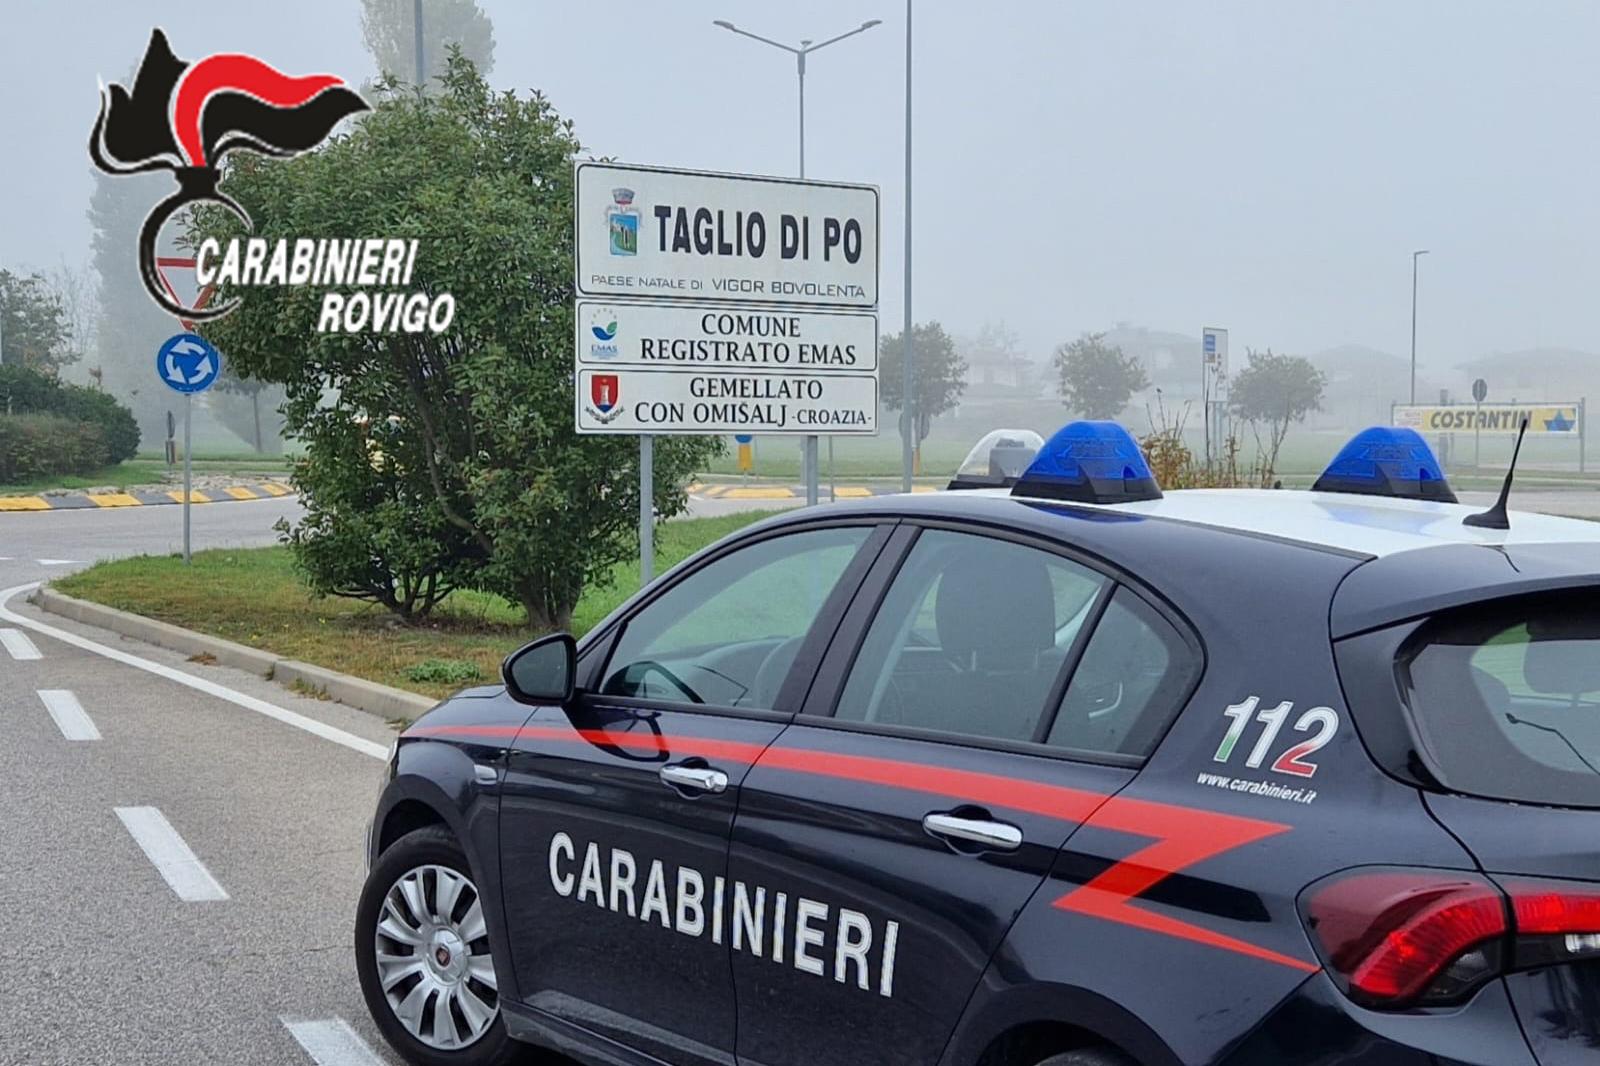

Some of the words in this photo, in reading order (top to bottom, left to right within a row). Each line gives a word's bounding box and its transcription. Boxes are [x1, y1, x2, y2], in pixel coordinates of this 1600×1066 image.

[654, 205, 766, 258] TAGLIO
[780, 214, 809, 260] DI
[823, 217, 862, 264] PO
[591, 274, 633, 287] PAESE
[638, 277, 686, 289] NATALE
[712, 278, 764, 293] VIGOR
[771, 281, 866, 298] BOVOLENTA
[701, 313, 801, 337] COMUNE
[591, 344, 617, 353] EMAS
[640, 338, 790, 364] REGISTRATO
[798, 344, 856, 365] EMAS
[689, 377, 823, 399] GEMELLATO
[634, 402, 684, 423] CON
[693, 401, 788, 427] OMIŠALJ
[1430, 410, 1532, 430] COSTANTIN
[1213, 696, 1339, 778] 112
[1197, 771, 1317, 804] www.carabinieri.it
[548, 831, 899, 998] CARABINIERI
